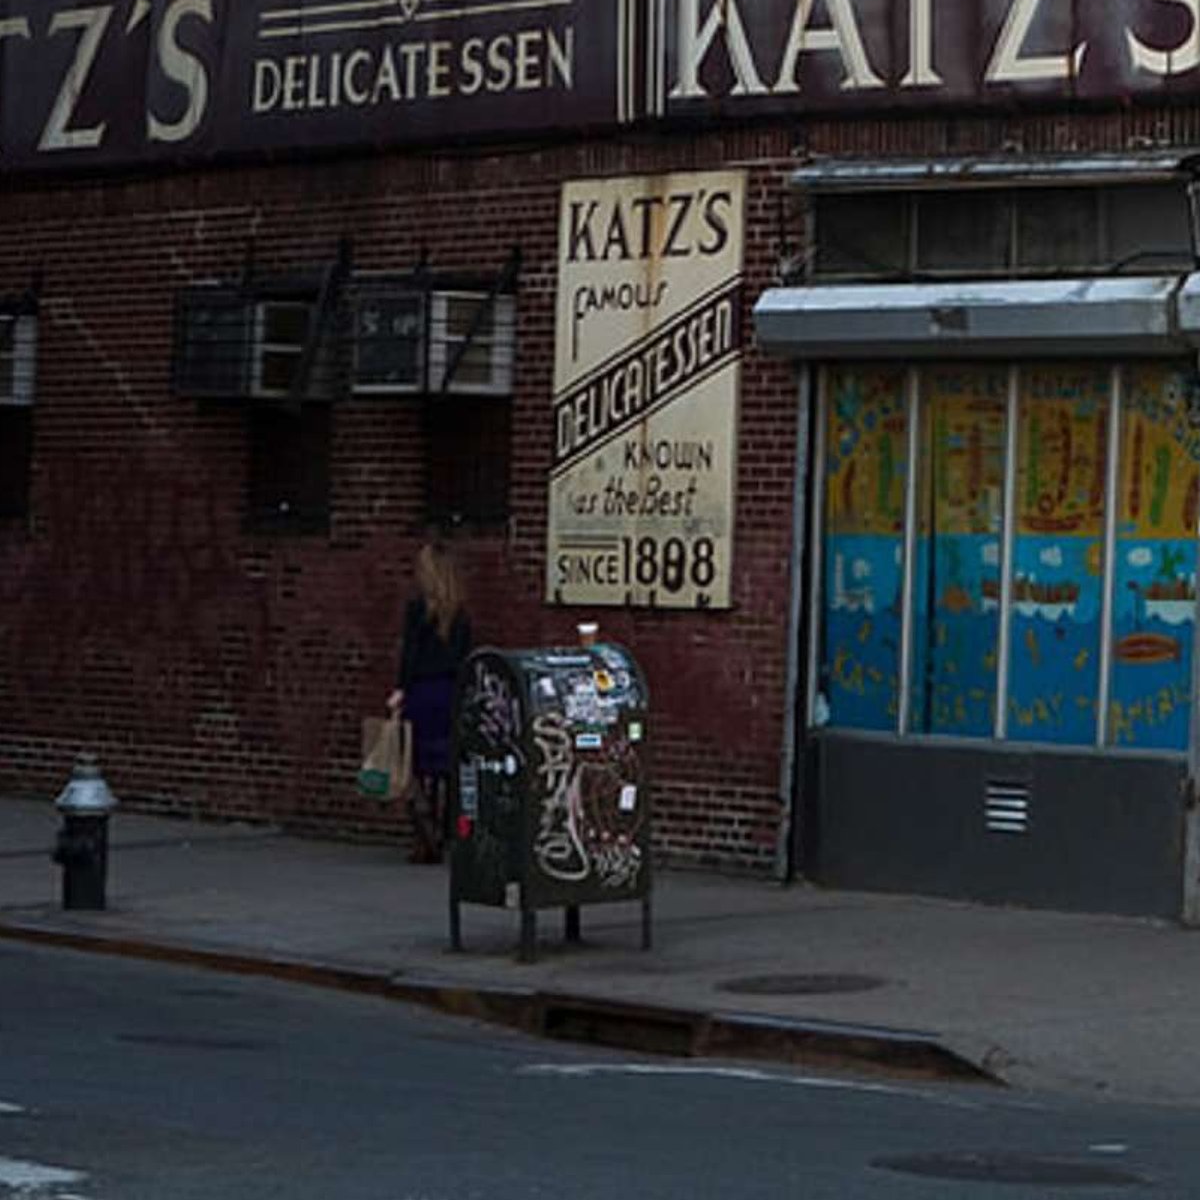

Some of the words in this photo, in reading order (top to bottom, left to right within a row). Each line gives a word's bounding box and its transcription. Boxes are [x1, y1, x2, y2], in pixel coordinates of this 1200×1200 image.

[252, 26, 575, 114] DELICATESSEN
[567, 188, 732, 263] KATZ'S
[556, 299, 733, 458] DELICATESSEN
[623, 440, 713, 469] KNOWN
[558, 553, 620, 585] SINCE
